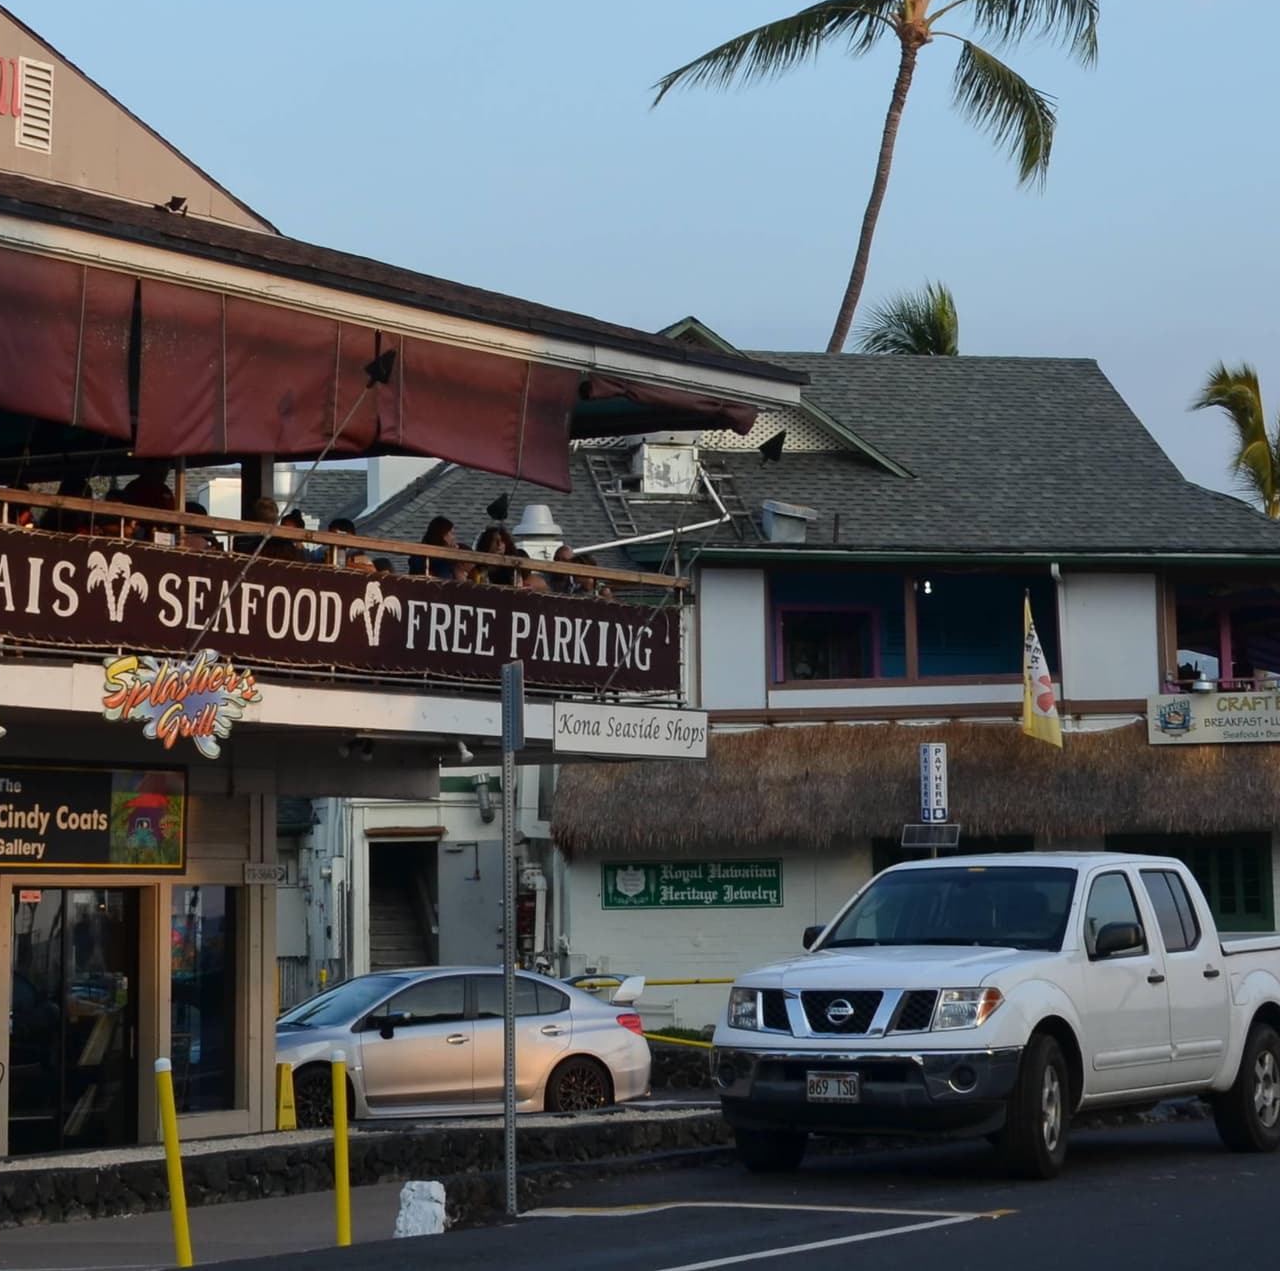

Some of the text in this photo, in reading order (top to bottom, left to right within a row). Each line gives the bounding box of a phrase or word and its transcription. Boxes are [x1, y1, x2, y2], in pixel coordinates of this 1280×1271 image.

[157, 571, 342, 644] SEAFOOD
[406, 600, 495, 657] FREE
[509, 611, 653, 672] PARKING
[1216, 695, 1272, 713] CRAFT
[157, 703, 218, 749] Grill
[558, 713, 705, 749] Kona Seaside Shops
[1204, 716, 1263, 728] BREAKFAST
[934, 748, 942, 772] PAY
[56, 805, 109, 832] Coats
[659, 864, 703, 884] Royal
[707, 863, 776, 883] Hawaiian
[659, 885, 719, 904] Heritage
[722, 884, 777, 904] Jewelry
[808, 1079, 829, 1096] 869
